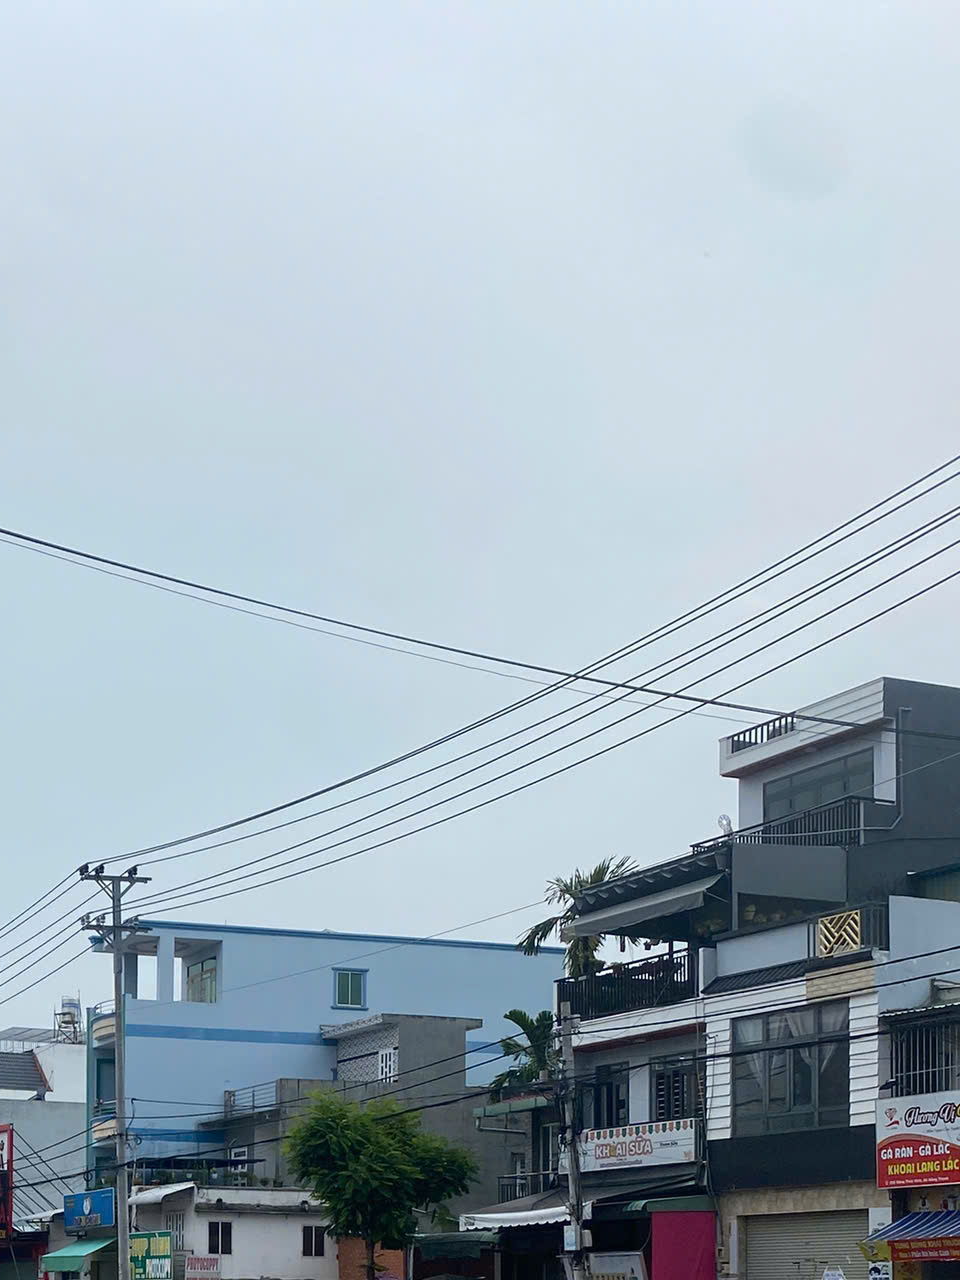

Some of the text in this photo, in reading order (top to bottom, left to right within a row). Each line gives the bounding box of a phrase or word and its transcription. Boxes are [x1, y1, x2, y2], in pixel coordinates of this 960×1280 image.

[880, 1147, 893, 1160] GÀ
[918, 1143, 932, 1156] GÀ
[887, 1163, 915, 1176] KHOAI
[916, 1160, 940, 1173] LANG
